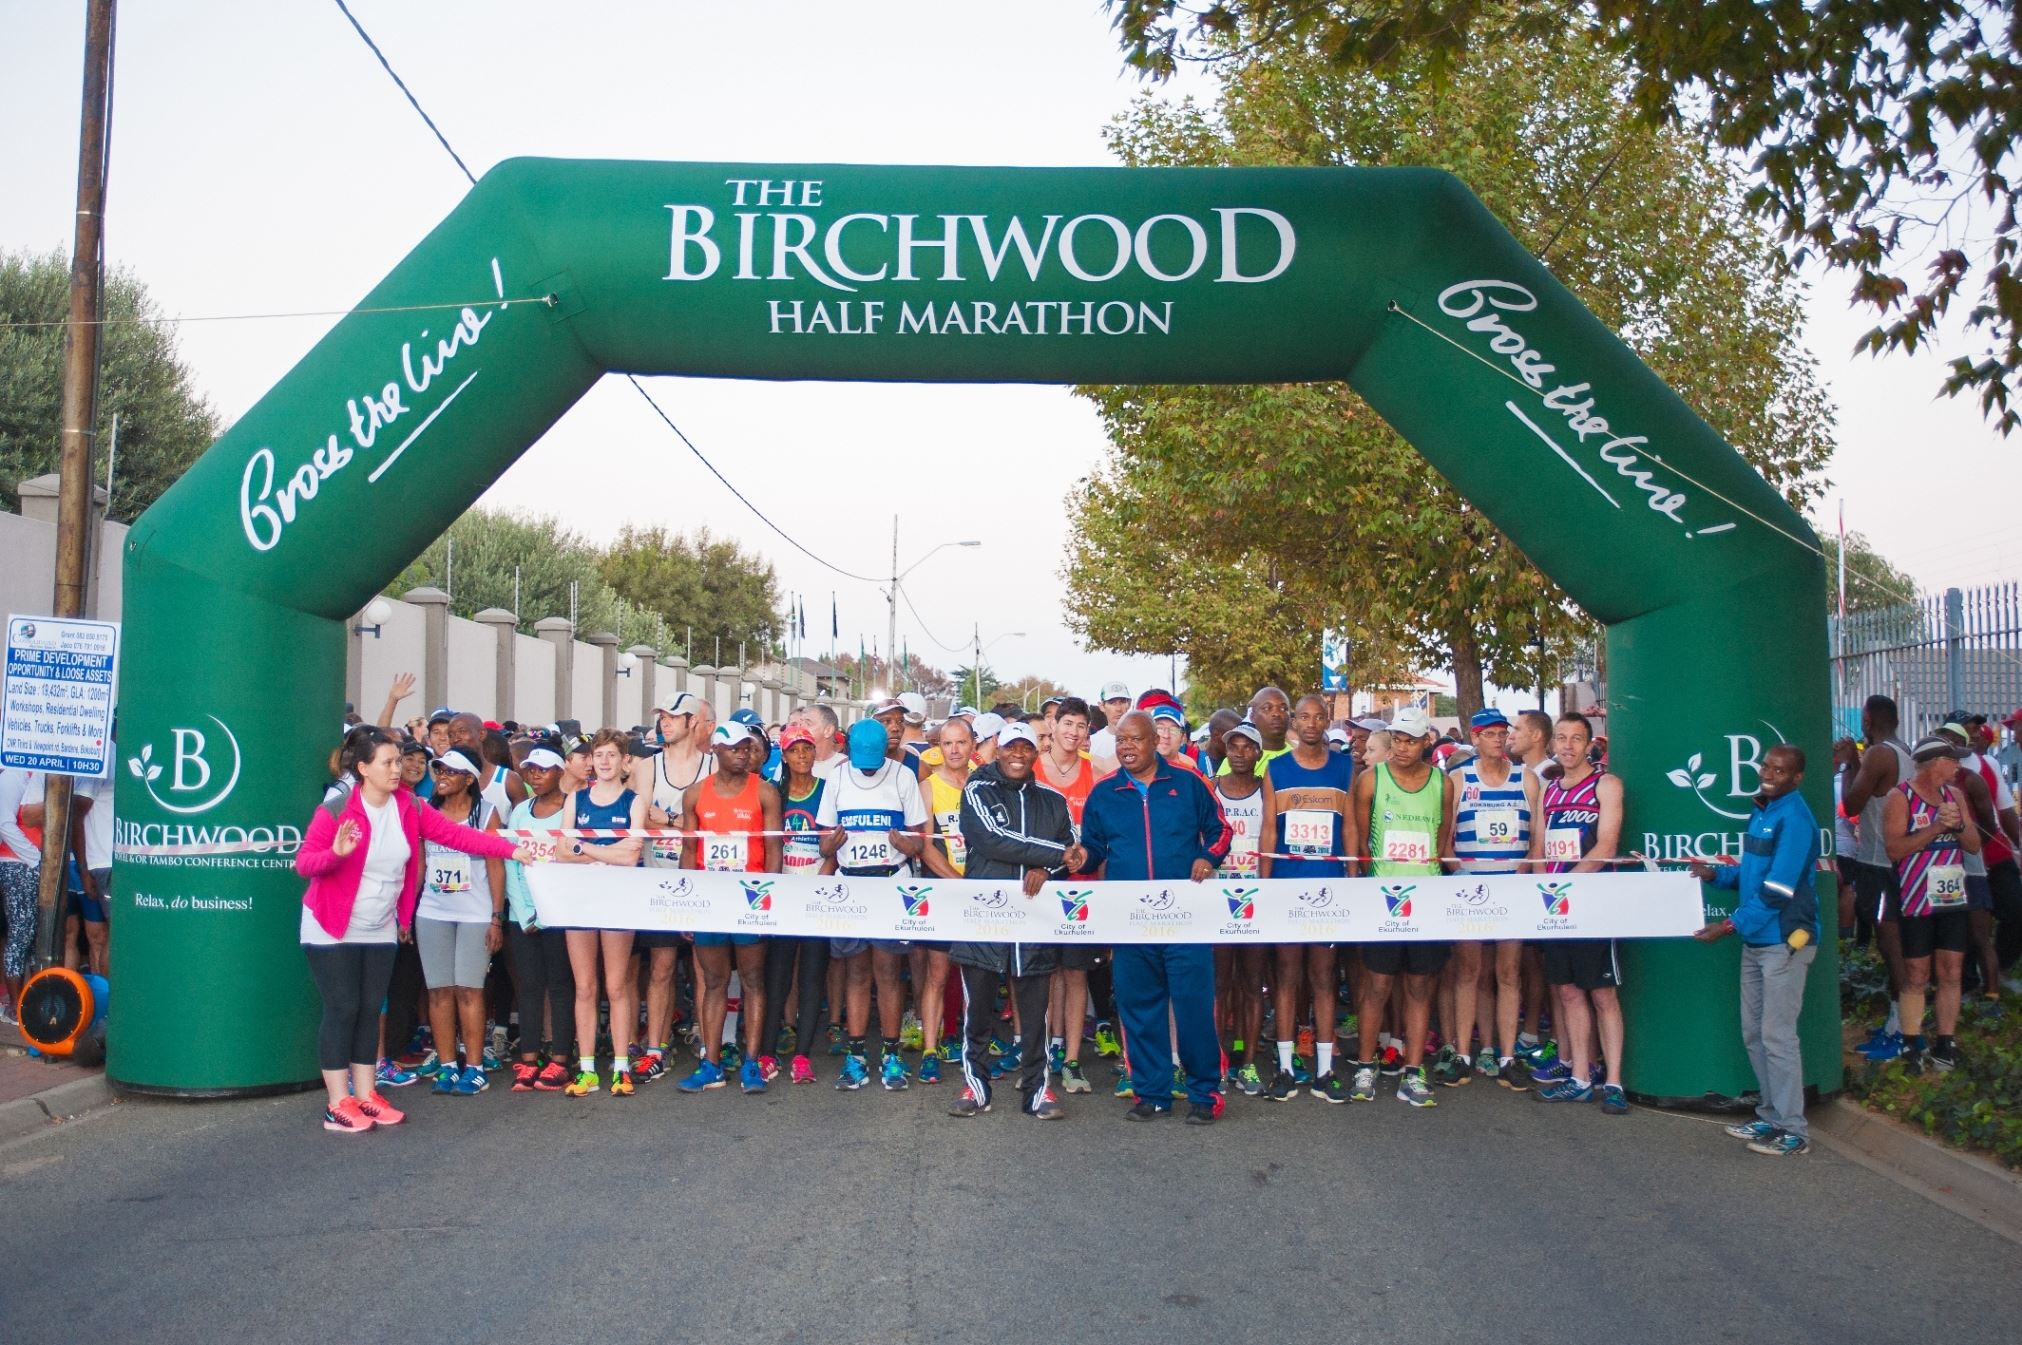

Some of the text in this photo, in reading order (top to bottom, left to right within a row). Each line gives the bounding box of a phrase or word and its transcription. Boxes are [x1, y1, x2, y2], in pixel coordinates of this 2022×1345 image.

[726, 179, 823, 207] THE
[662, 203, 1296, 292] BIRCHWOOD
[767, 300, 1174, 335] HALF MARATHON
[1438, 279, 1555, 388] Cross
[1543, 382, 1609, 443] the
[240, 435, 353, 550] Cross
[348, 383, 410, 447] the
[14, 649, 108, 668] PRIME DEVELOPMENT
[8, 662, 112, 683] OPPORTUNITY & LOOSE ASSETS
[8, 683, 24, 695] Land
[46, 702, 78, 717] Residential
[79, 705, 105, 721] Dwelling
[57, 721, 80, 737] Forklifts
[87, 724, 103, 739] More
[5, 754, 100, 771] WED 20 APRIL 10H30
[170, 728, 211, 790] B
[1303, 795, 1333, 804] Eskom
[1466, 786, 1480, 801] 60
[1558, 809, 1600, 824] 2000
[115, 817, 301, 854] BIRCHWOOD
[1290, 824, 1330, 840] 3313
[1489, 822, 1508, 837] 59
[711, 844, 738, 860] 261
[850, 844, 888, 861] 1248
[1388, 842, 1427, 859] 2281
[135, 855, 147, 865] OR
[149, 856, 183, 866] TAMBO
[184, 857, 260, 868] CONFERENCE
[262, 859, 298, 869] CENTR
[435, 868, 462, 884] 371
[1936, 879, 1961, 894] 364
[135, 893, 253, 910] Relax, do business!
[902, 919, 917, 927] City
[1060, 923, 1075, 931] City
[1226, 922, 1241, 930] City
[1384, 920, 1399, 928] City
